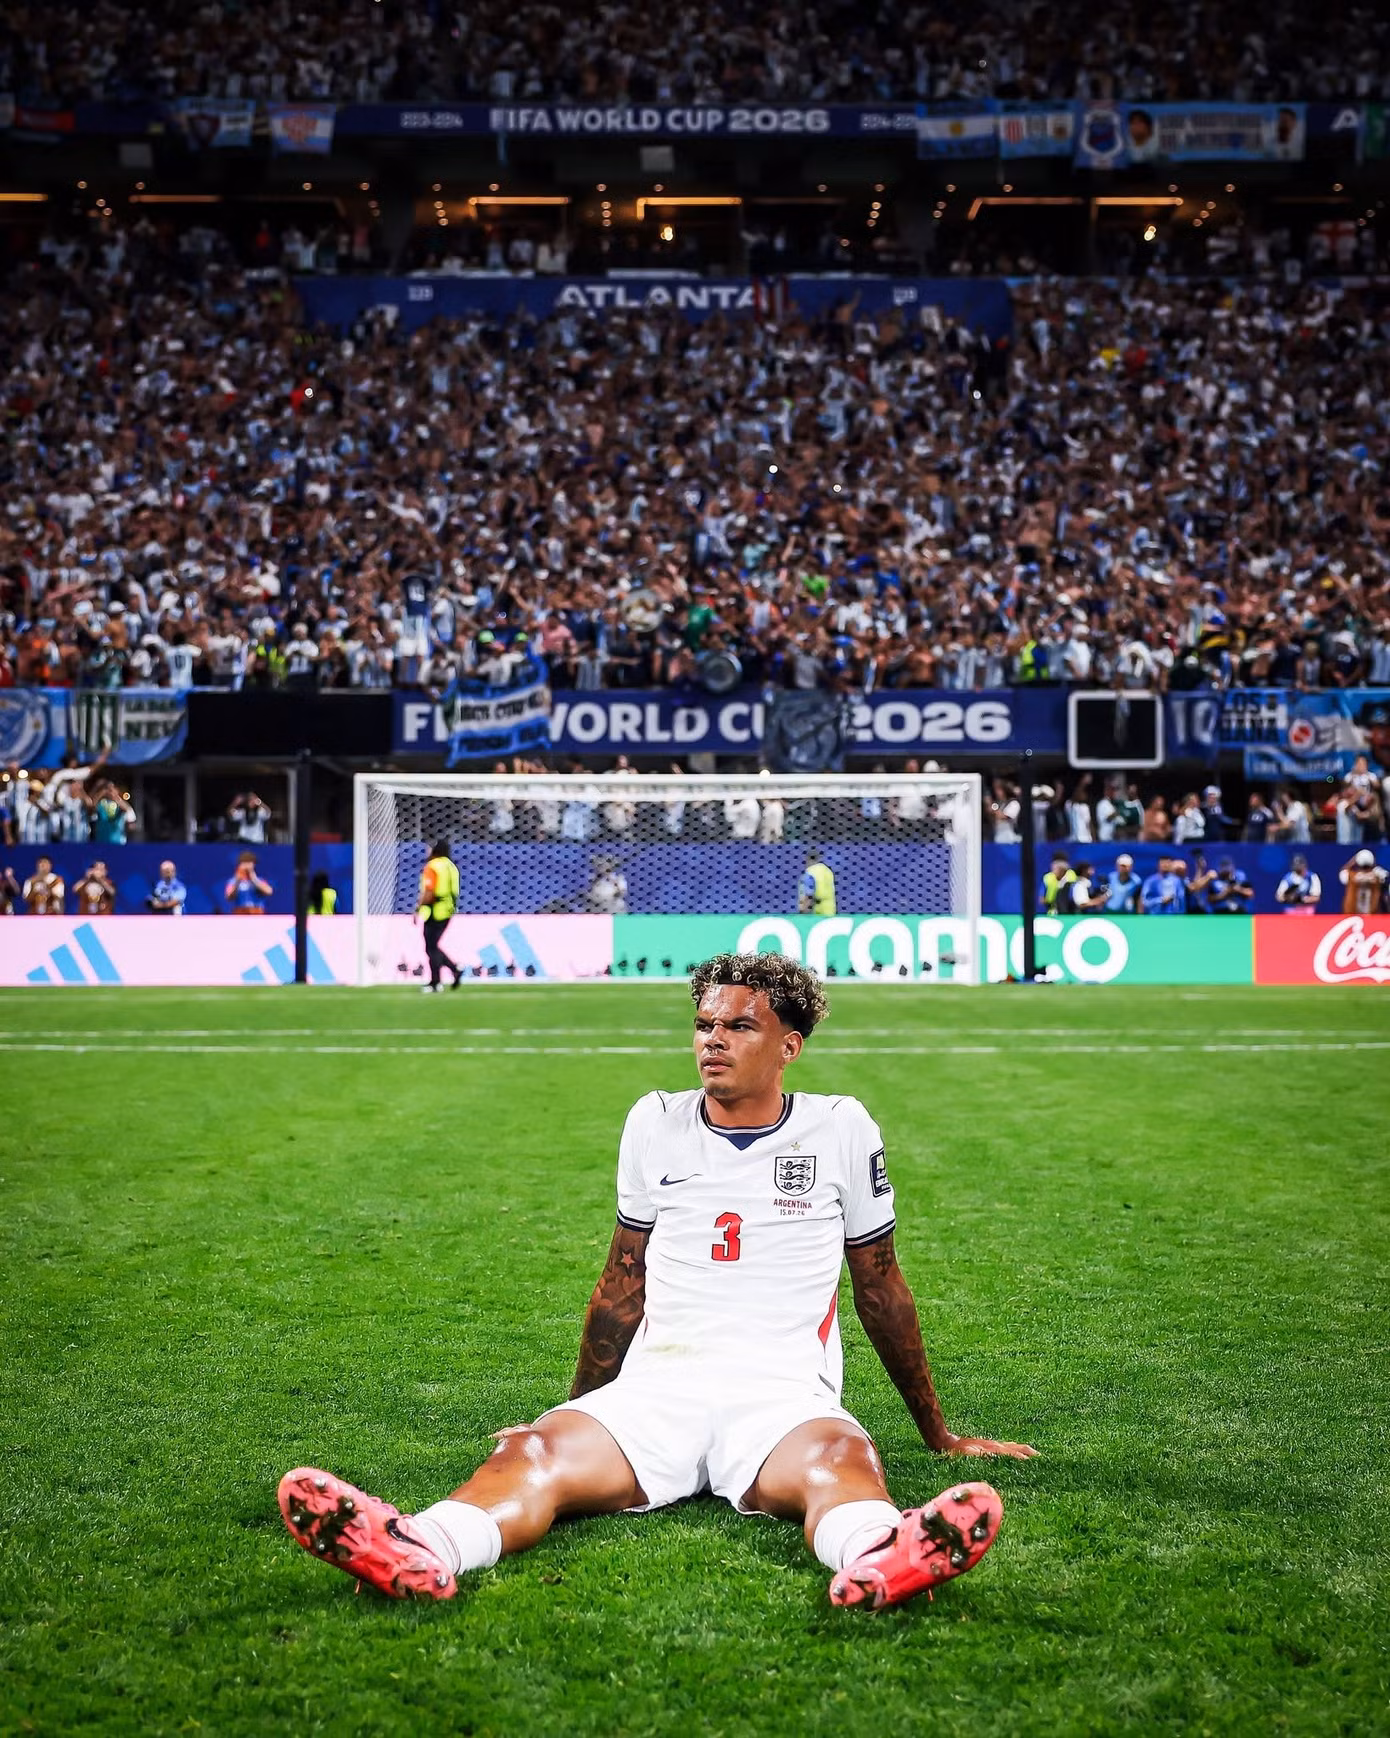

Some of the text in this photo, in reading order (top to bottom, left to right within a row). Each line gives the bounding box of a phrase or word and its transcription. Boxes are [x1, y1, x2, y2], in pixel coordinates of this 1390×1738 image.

[489, 108, 830, 132] FIFA WORLD CUP 2026
[556, 285, 766, 308] ATLANTA
[773, 1198, 812, 1209] ARGENTINA
[711, 1211, 743, 1261] 3
